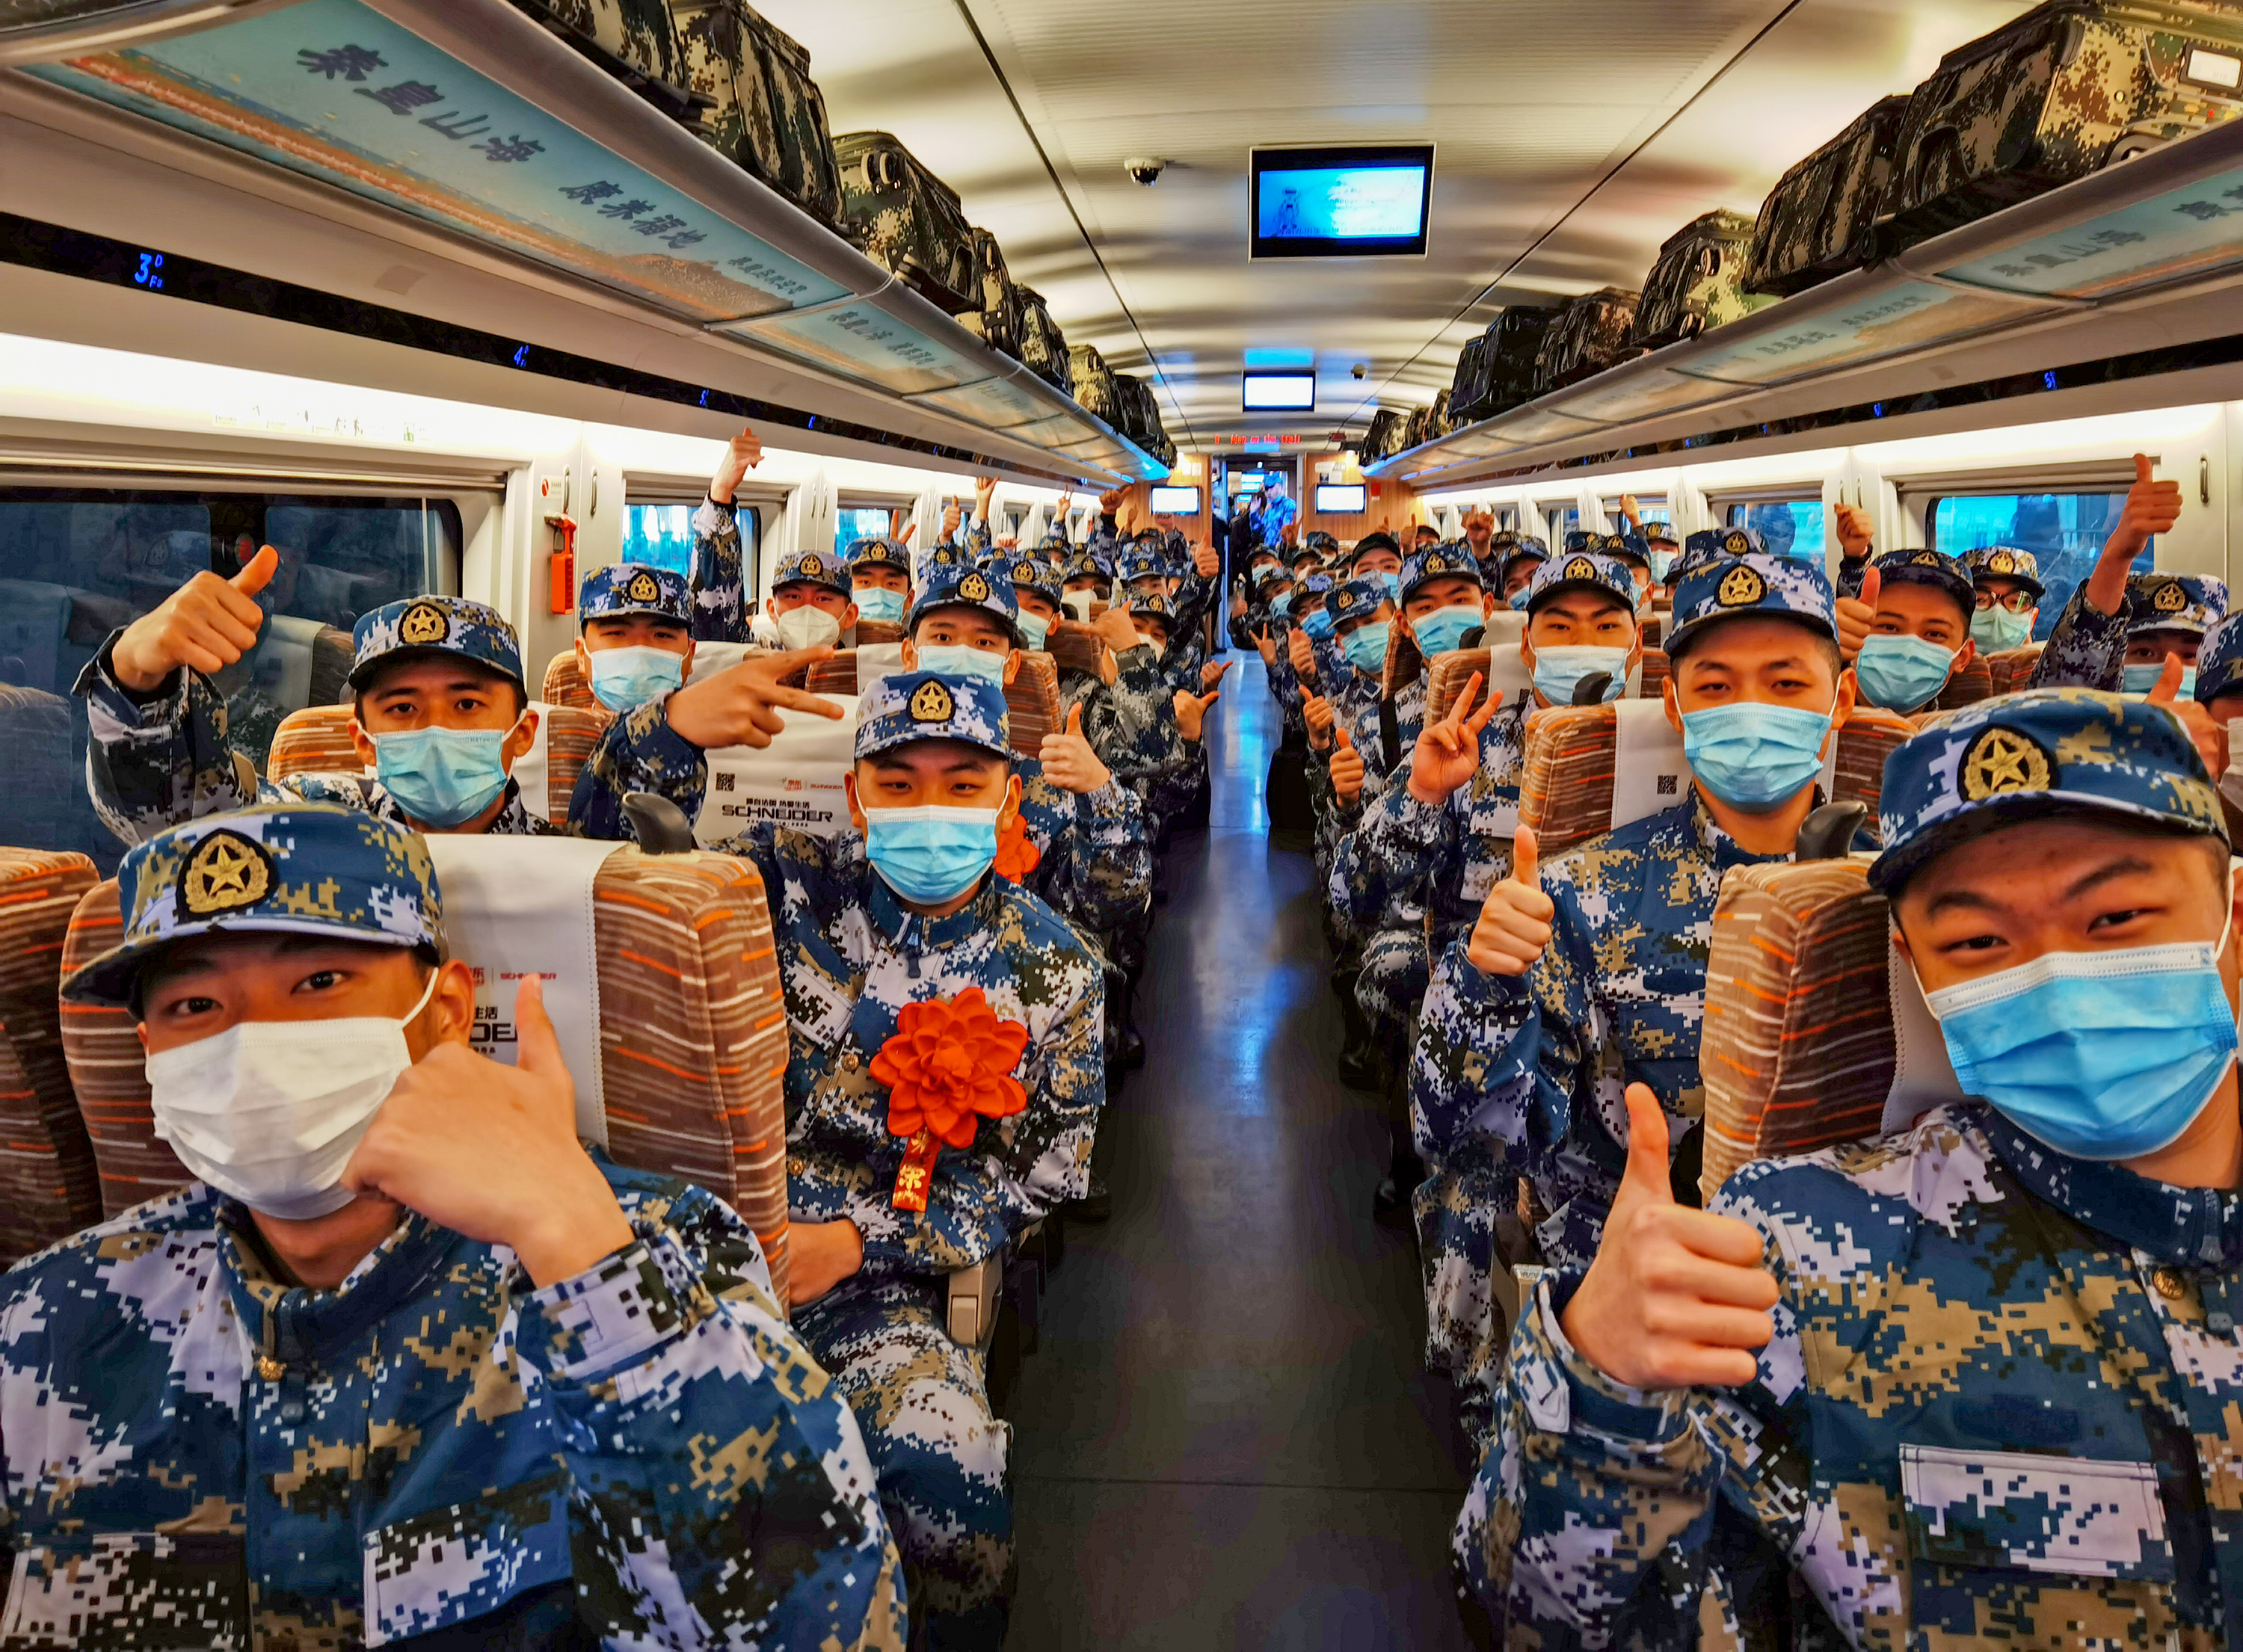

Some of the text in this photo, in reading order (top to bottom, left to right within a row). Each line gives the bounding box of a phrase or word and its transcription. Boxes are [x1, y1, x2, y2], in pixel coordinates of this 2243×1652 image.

[297, 44, 707, 249] 秦皇山海 康养福地
[721, 804, 833, 822] SCHNEIDER
[470, 1023, 517, 1042] DE
